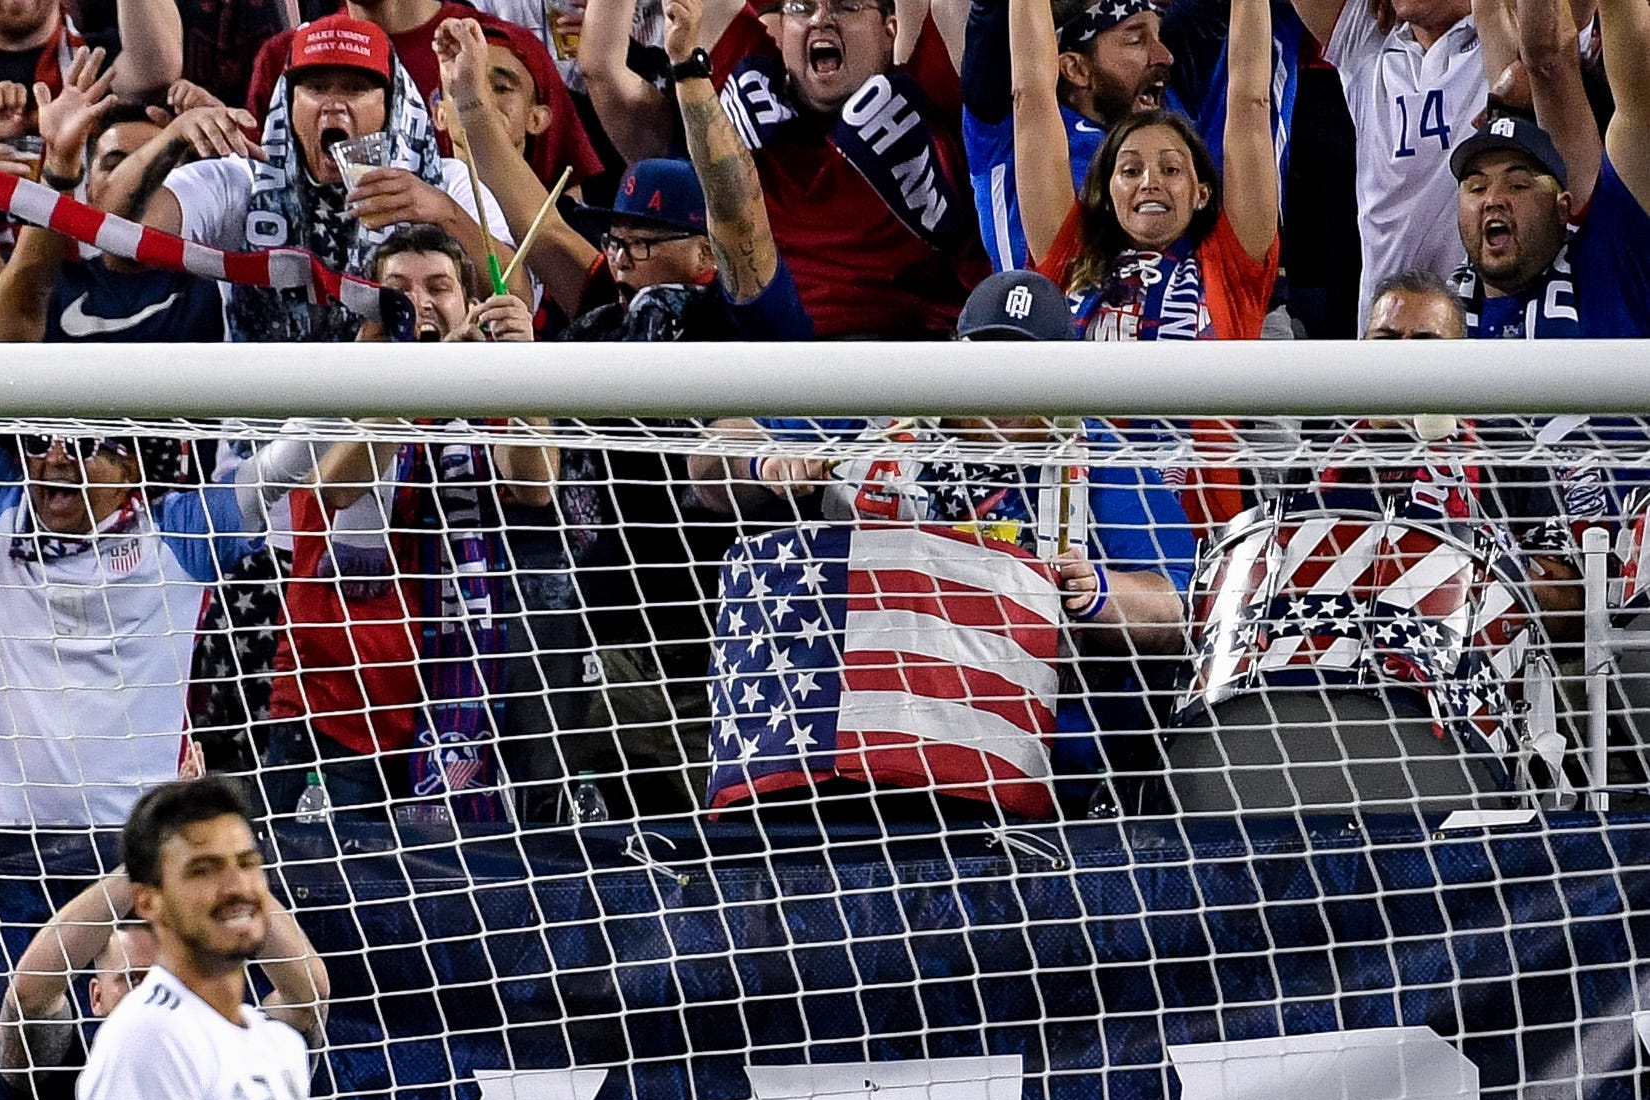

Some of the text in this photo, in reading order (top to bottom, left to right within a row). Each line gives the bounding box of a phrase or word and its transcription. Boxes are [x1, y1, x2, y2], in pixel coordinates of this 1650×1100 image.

[303, 41, 371, 57] GREAT AGAIN
[1394, 88, 1452, 159] 14
